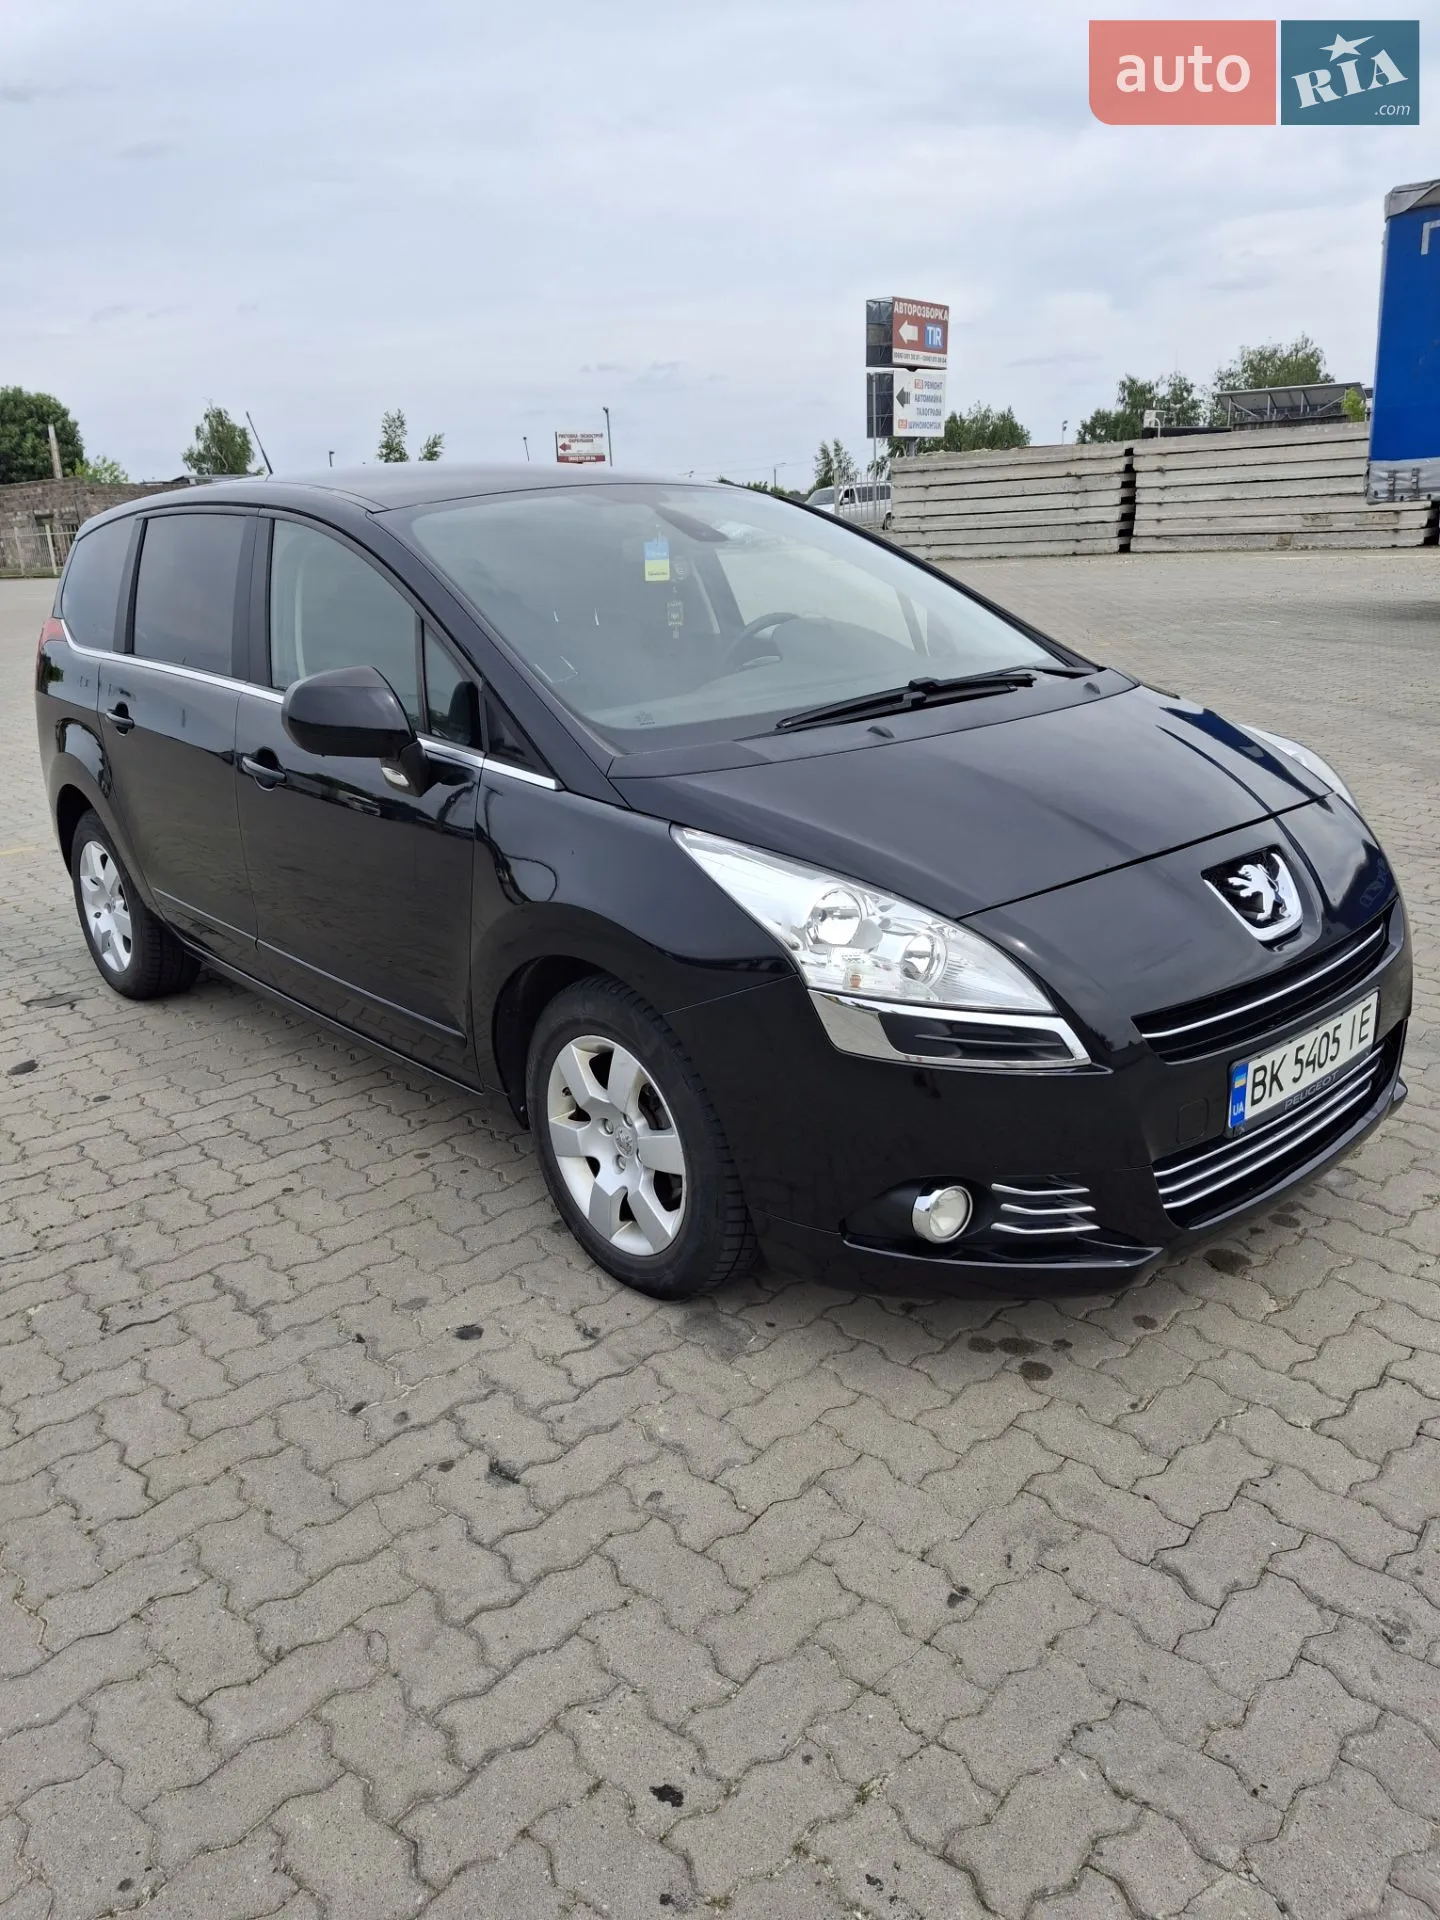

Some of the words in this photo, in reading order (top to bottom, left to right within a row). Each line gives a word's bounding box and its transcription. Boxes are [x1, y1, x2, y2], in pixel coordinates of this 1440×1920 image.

[893, 301, 949, 321] АВТОРОЗБОРКА
[926, 326, 943, 347] TIR
[1250, 1053, 1288, 1107] BK
[1292, 1023, 1342, 1084] 5405
[1350, 1003, 1372, 1051] IE
[1232, 1103, 1245, 1116] UA
